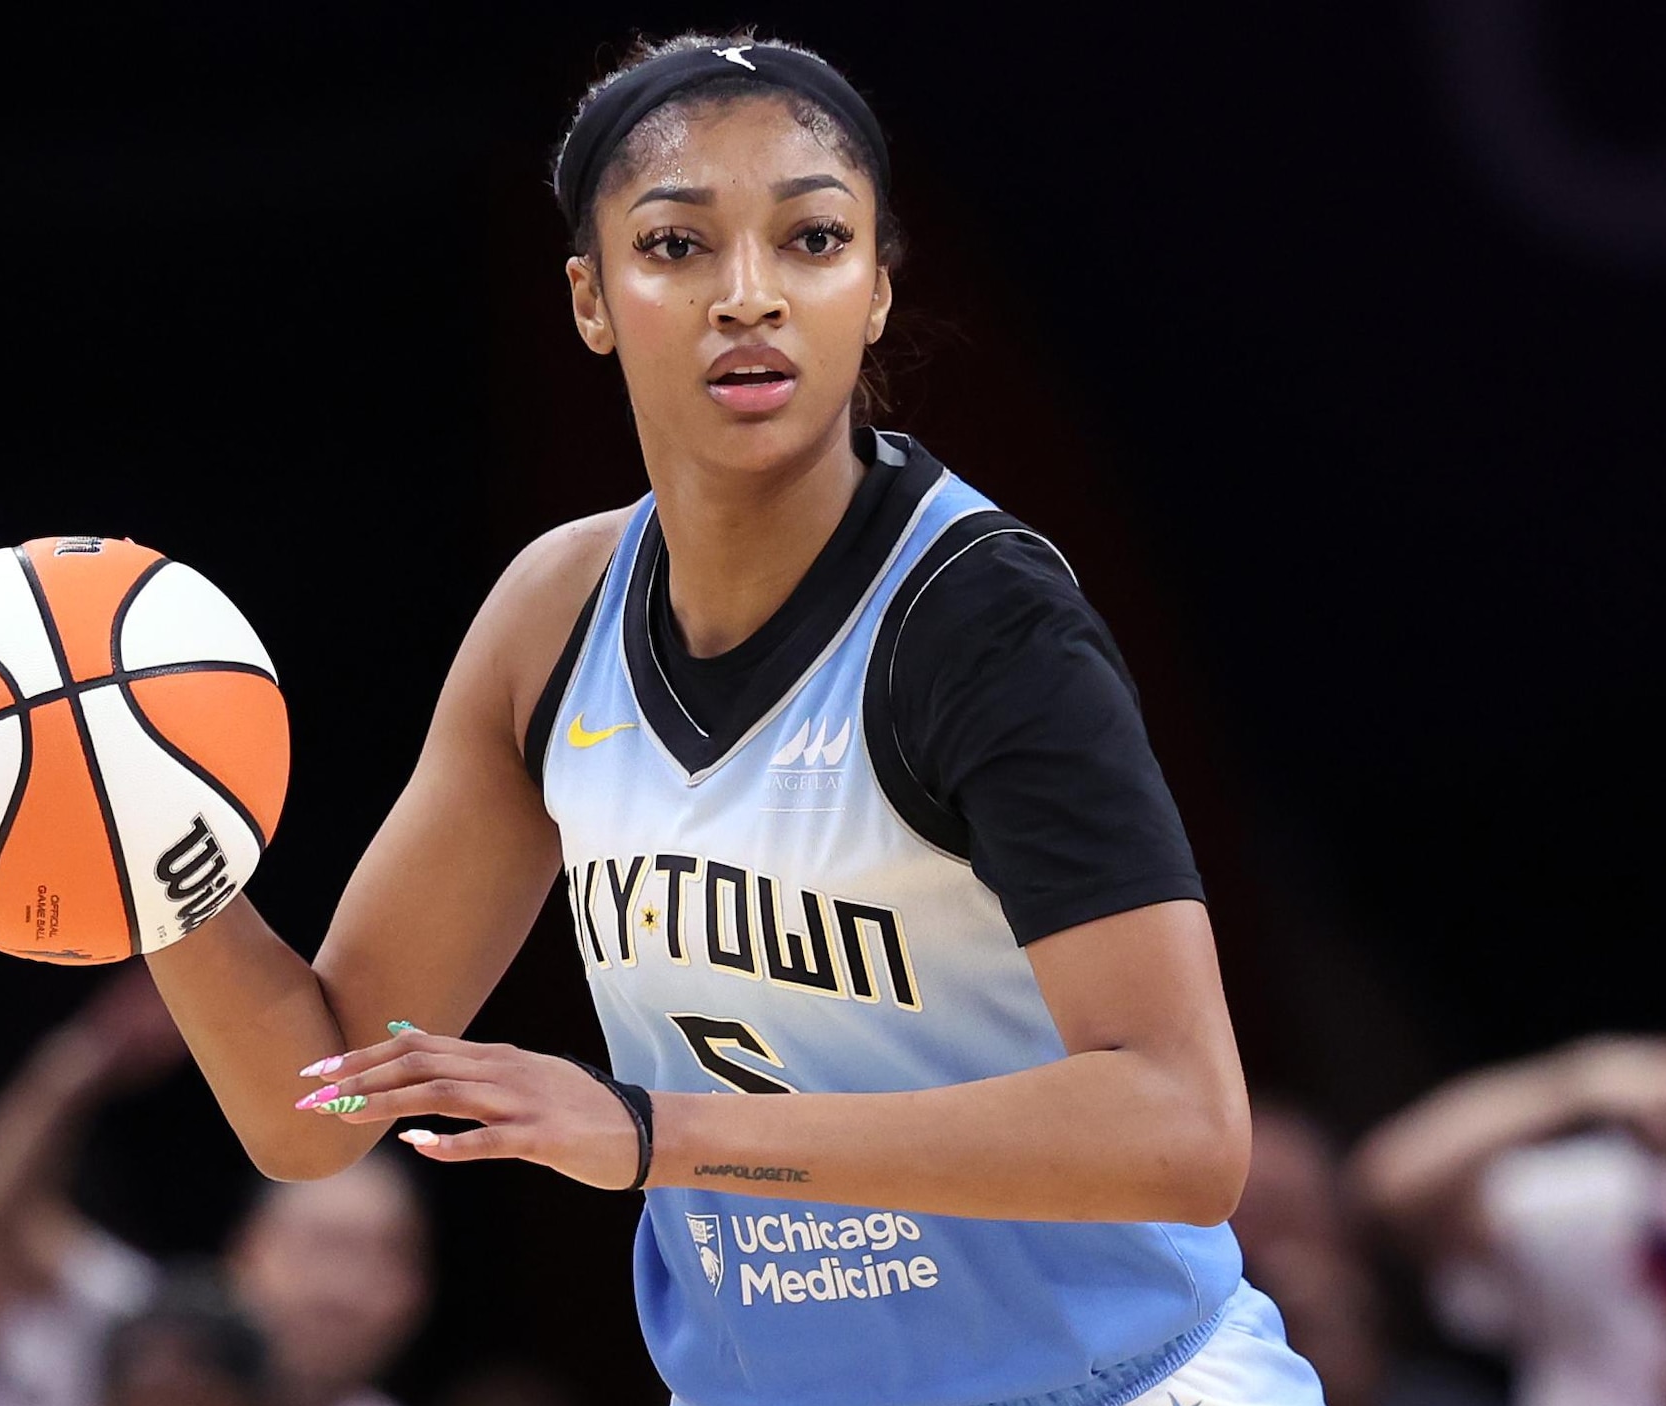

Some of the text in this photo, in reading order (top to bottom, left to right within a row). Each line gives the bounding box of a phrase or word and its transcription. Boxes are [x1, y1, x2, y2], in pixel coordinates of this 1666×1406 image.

[36, 884, 47, 941] GAME BALL
[48, 894, 60, 938] OFFICIAL
[694, 1164, 812, 1183] UNAPOLOGETIC
[731, 1202, 921, 1253] UChicago
[739, 1254, 939, 1306] Medicine
